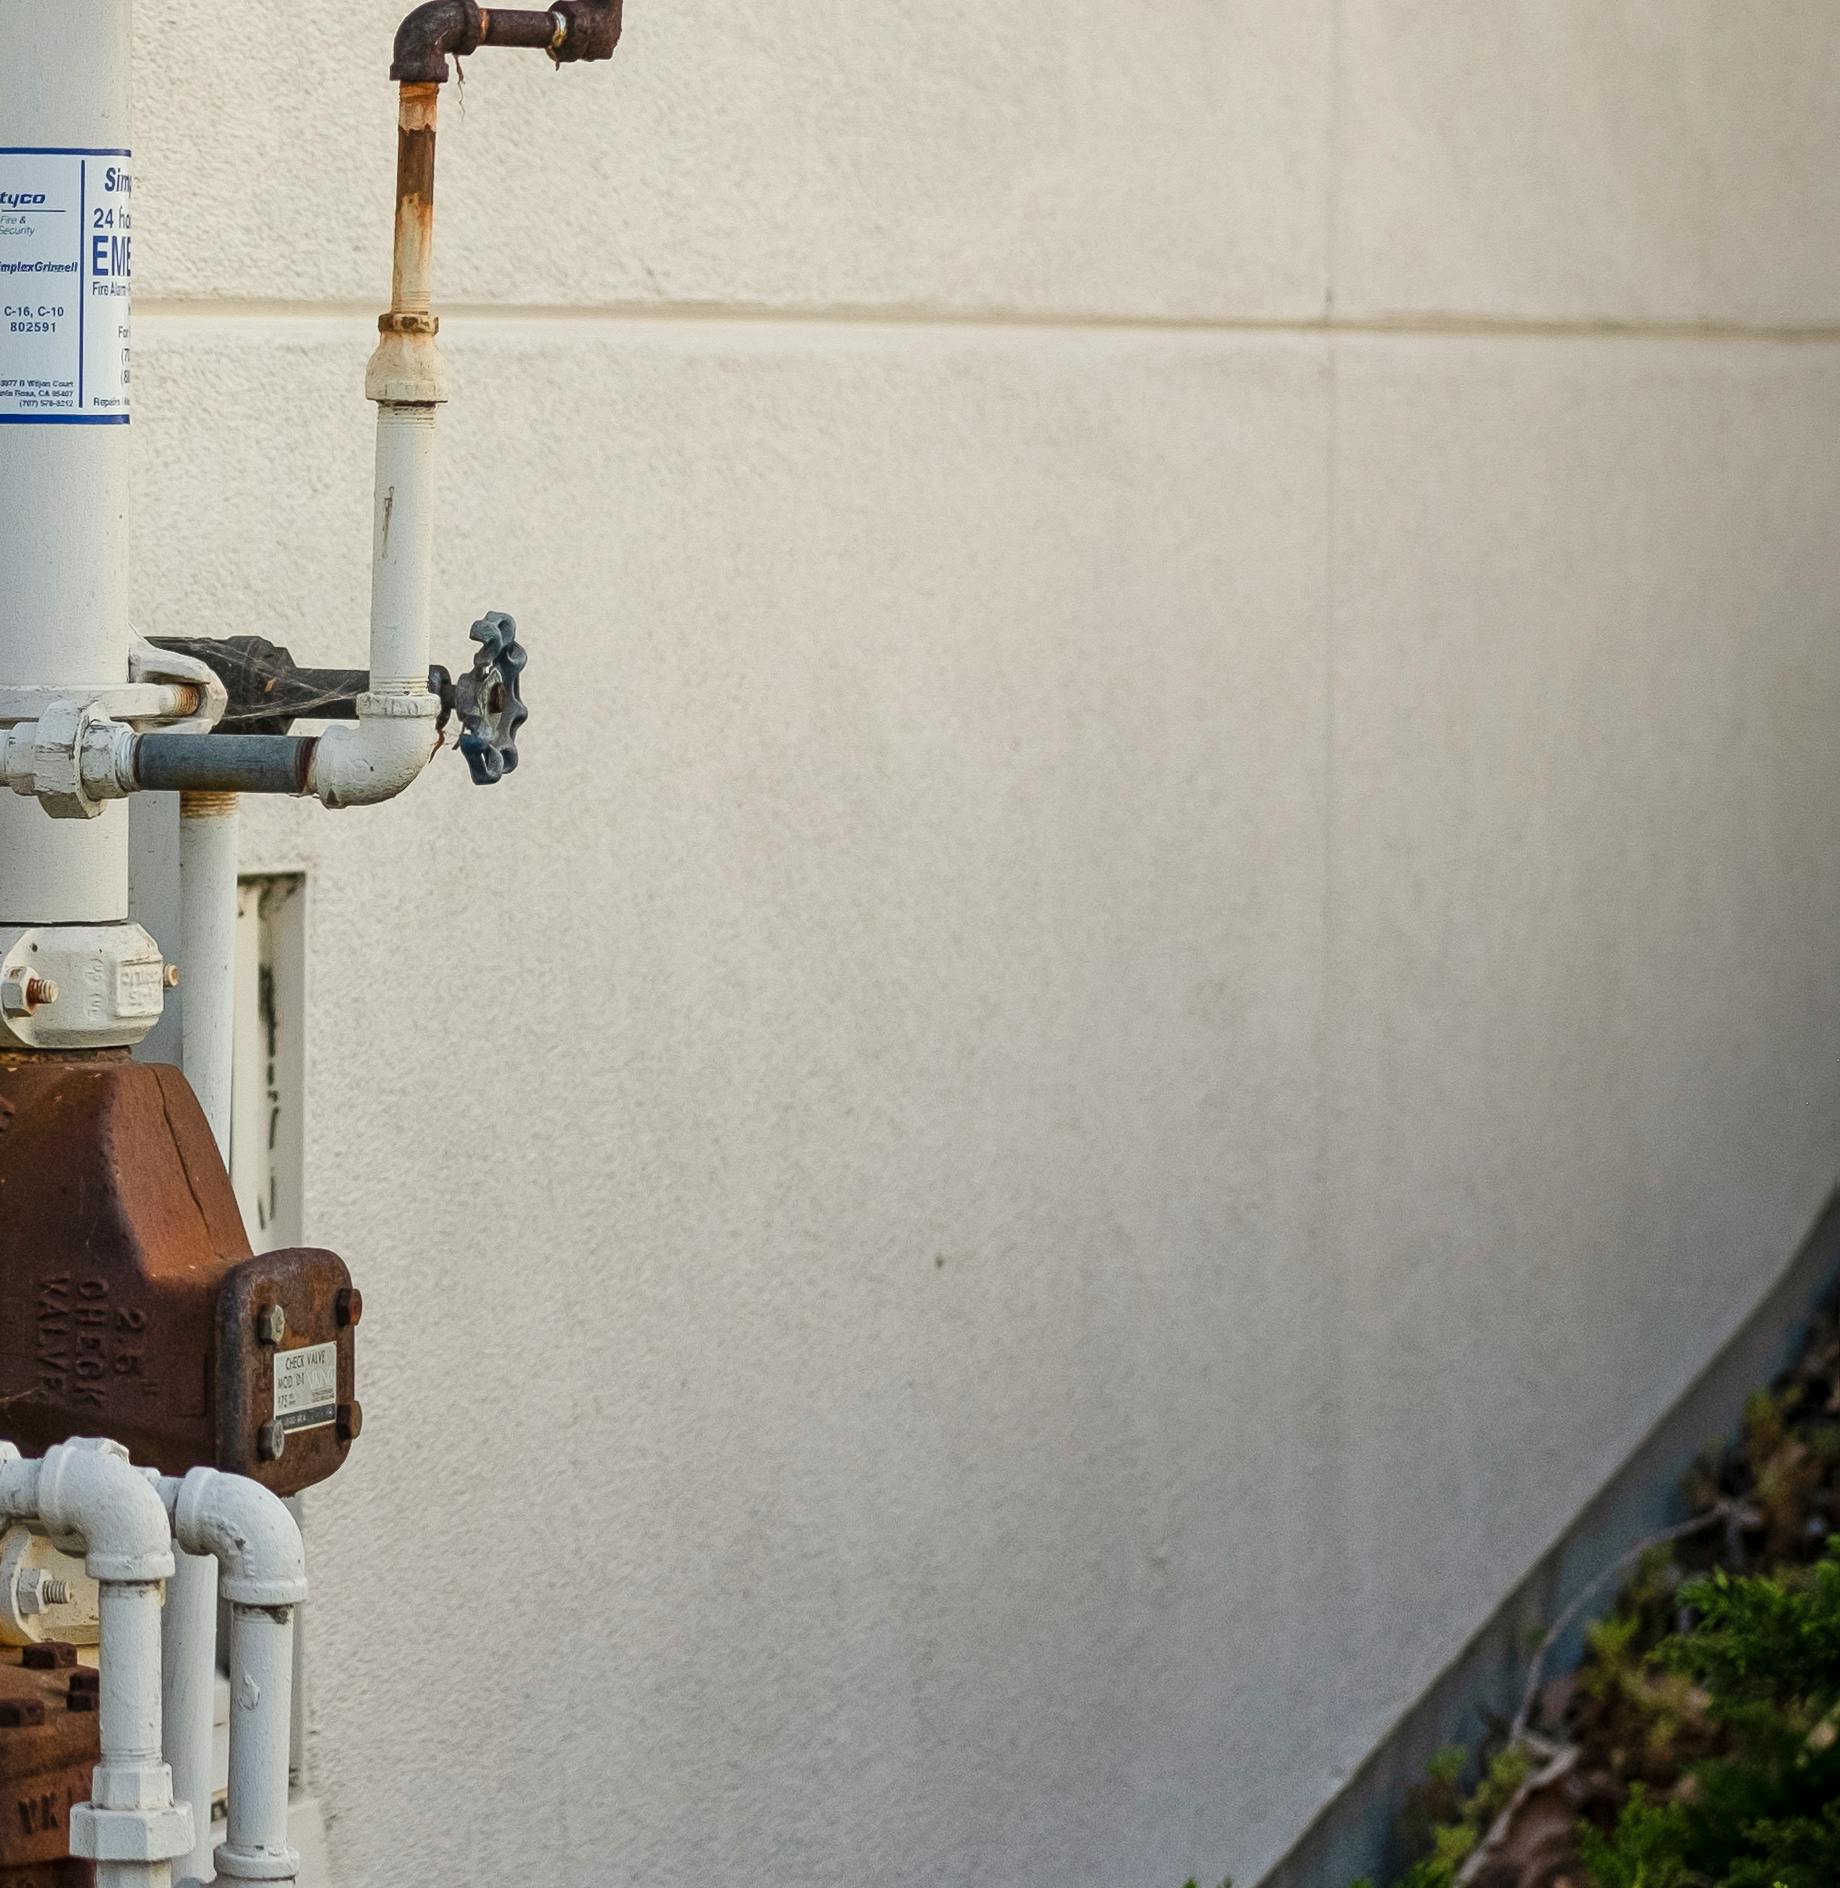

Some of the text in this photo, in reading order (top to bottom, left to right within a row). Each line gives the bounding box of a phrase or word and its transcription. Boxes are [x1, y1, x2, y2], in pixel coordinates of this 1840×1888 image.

[0, 216, 26, 224] Fire &
[93, 208, 114, 228] 24
[92, 282, 109, 296] Fire
[4, 306, 64, 318] C-16, C-10
[10, 322, 56, 332] 802591
[53, 379, 73, 387] Court
[19, 400, 38, 408] (707)
[37, 1271, 72, 1405] VALVE
[74, 1278, 110, 1409] CHECK
[285, 1350, 325, 1370] CHECK VALVE
